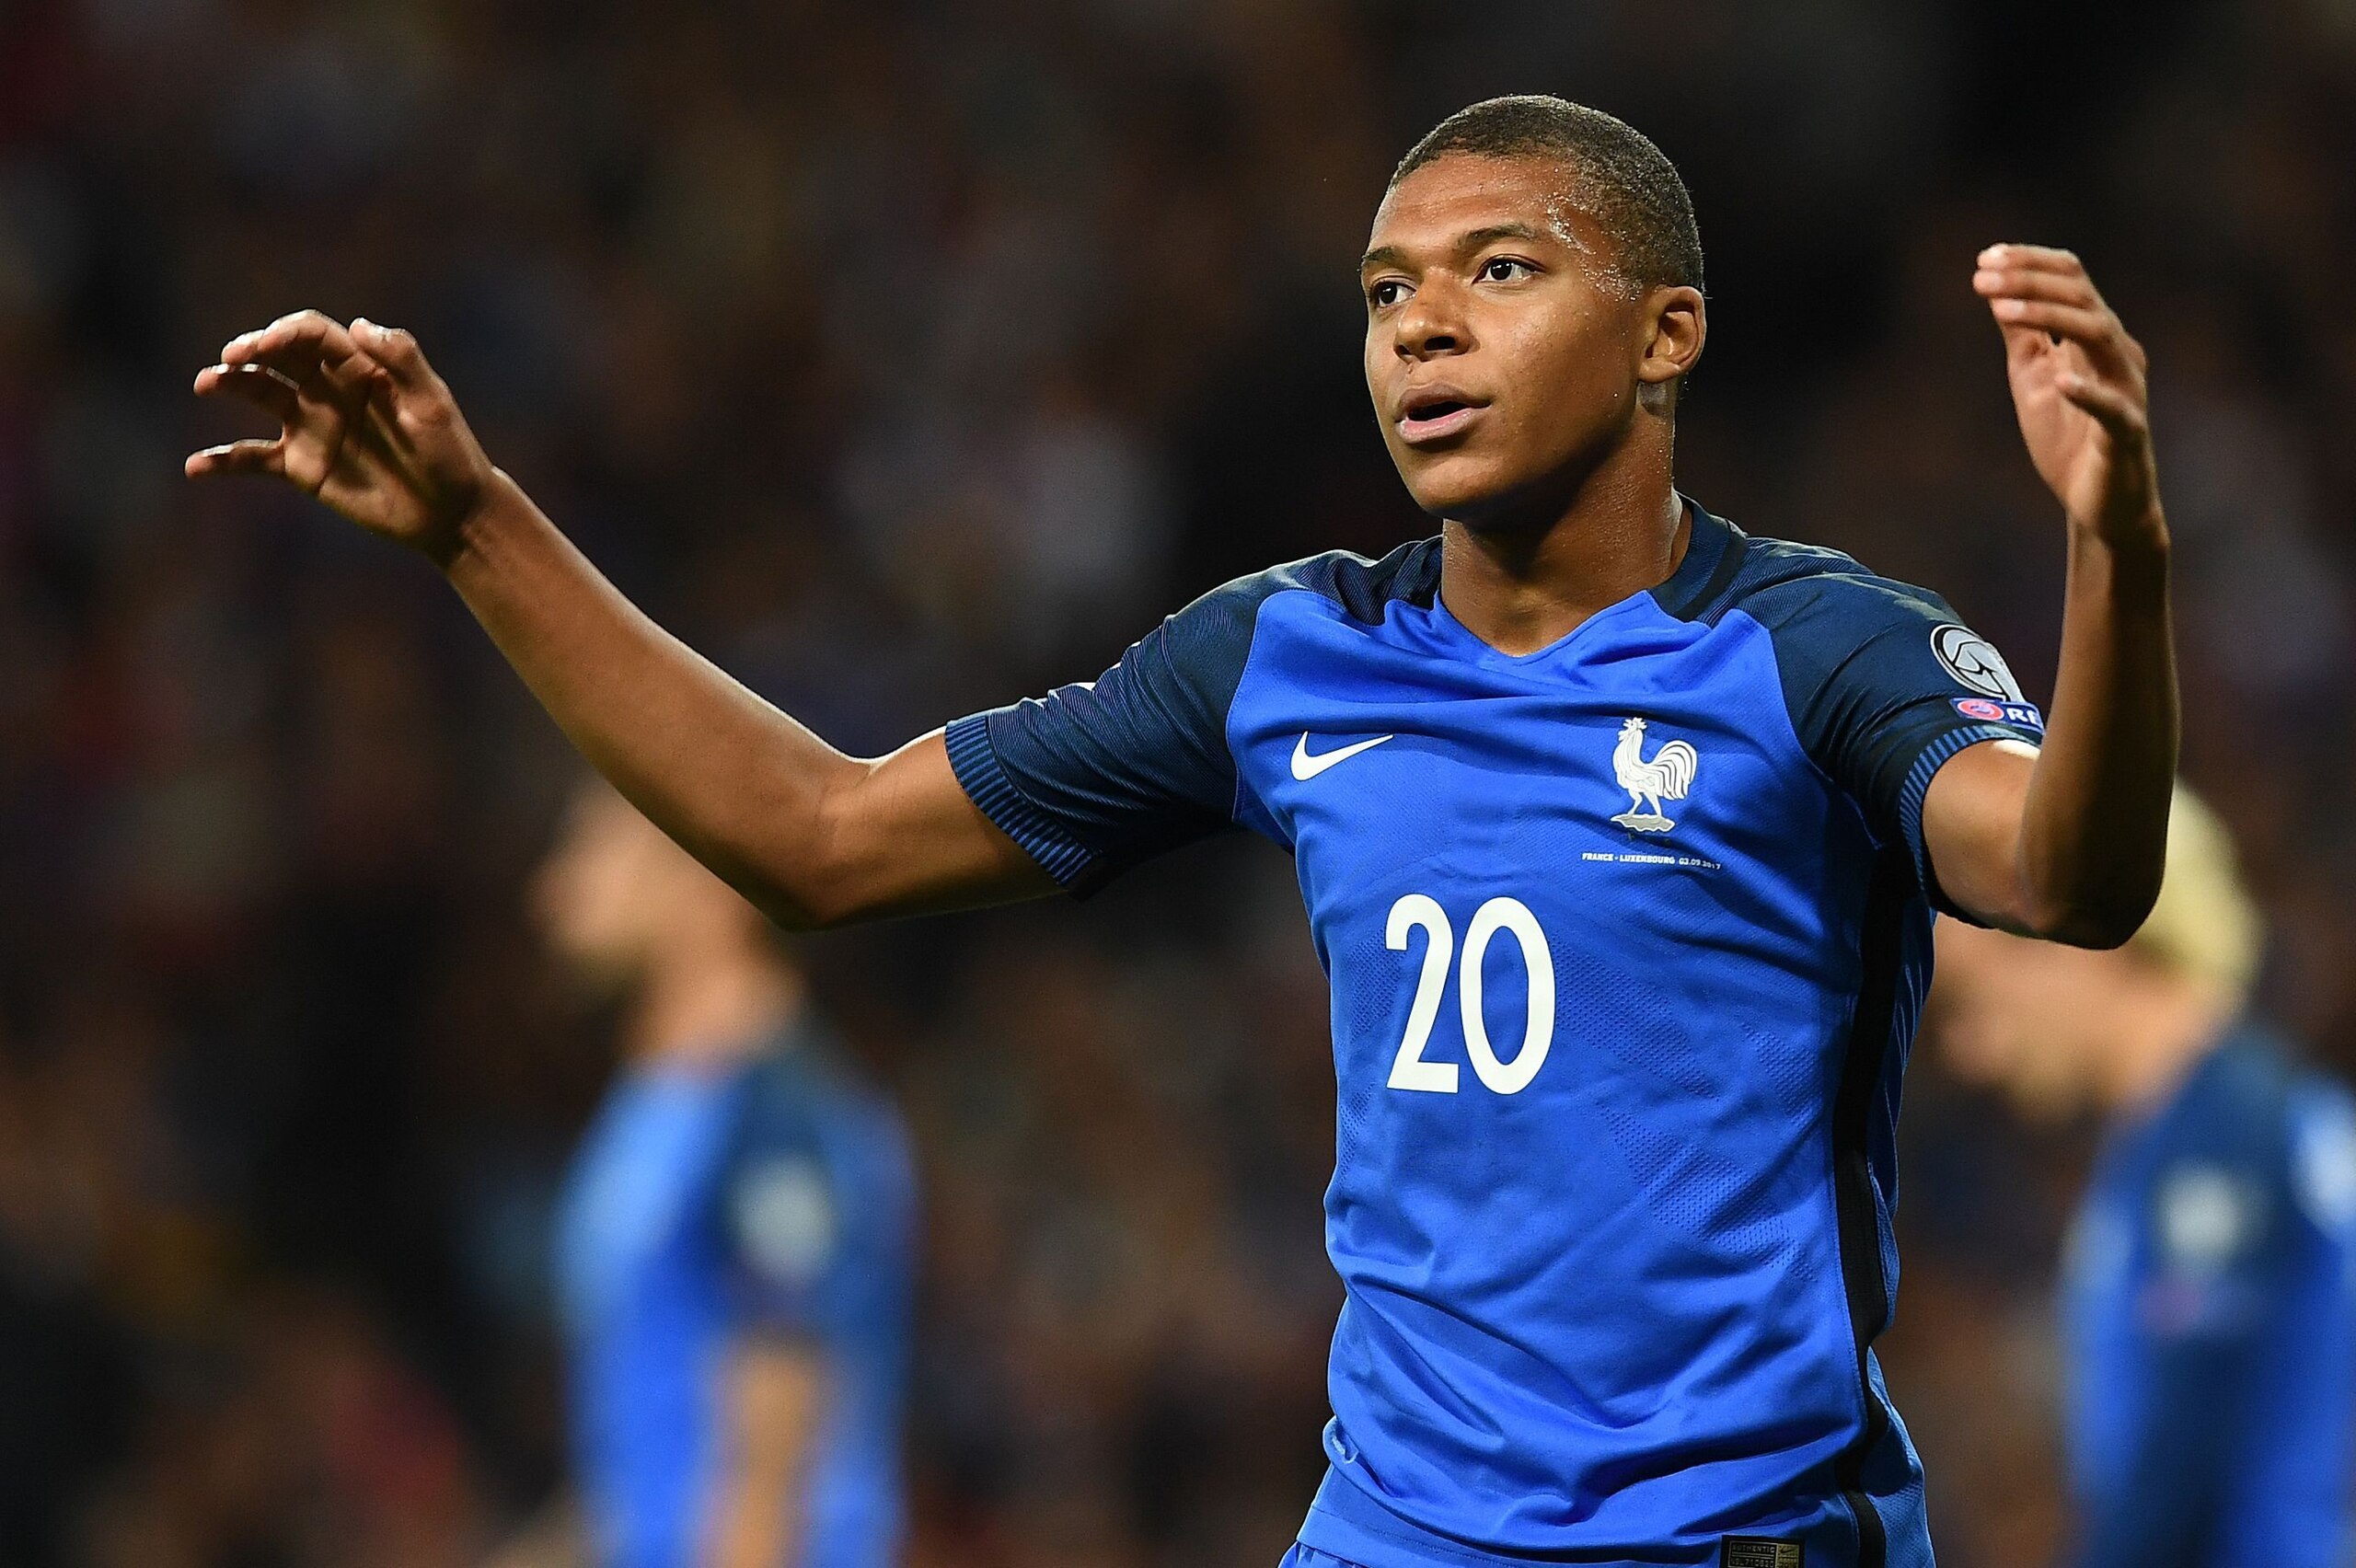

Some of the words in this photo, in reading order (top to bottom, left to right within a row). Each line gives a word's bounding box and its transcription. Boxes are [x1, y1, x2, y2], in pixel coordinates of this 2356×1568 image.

[1582, 853, 1613, 862] FRANCE
[1620, 854, 1675, 865] LUXEMBOURG
[1385, 893, 1556, 1095] 20
